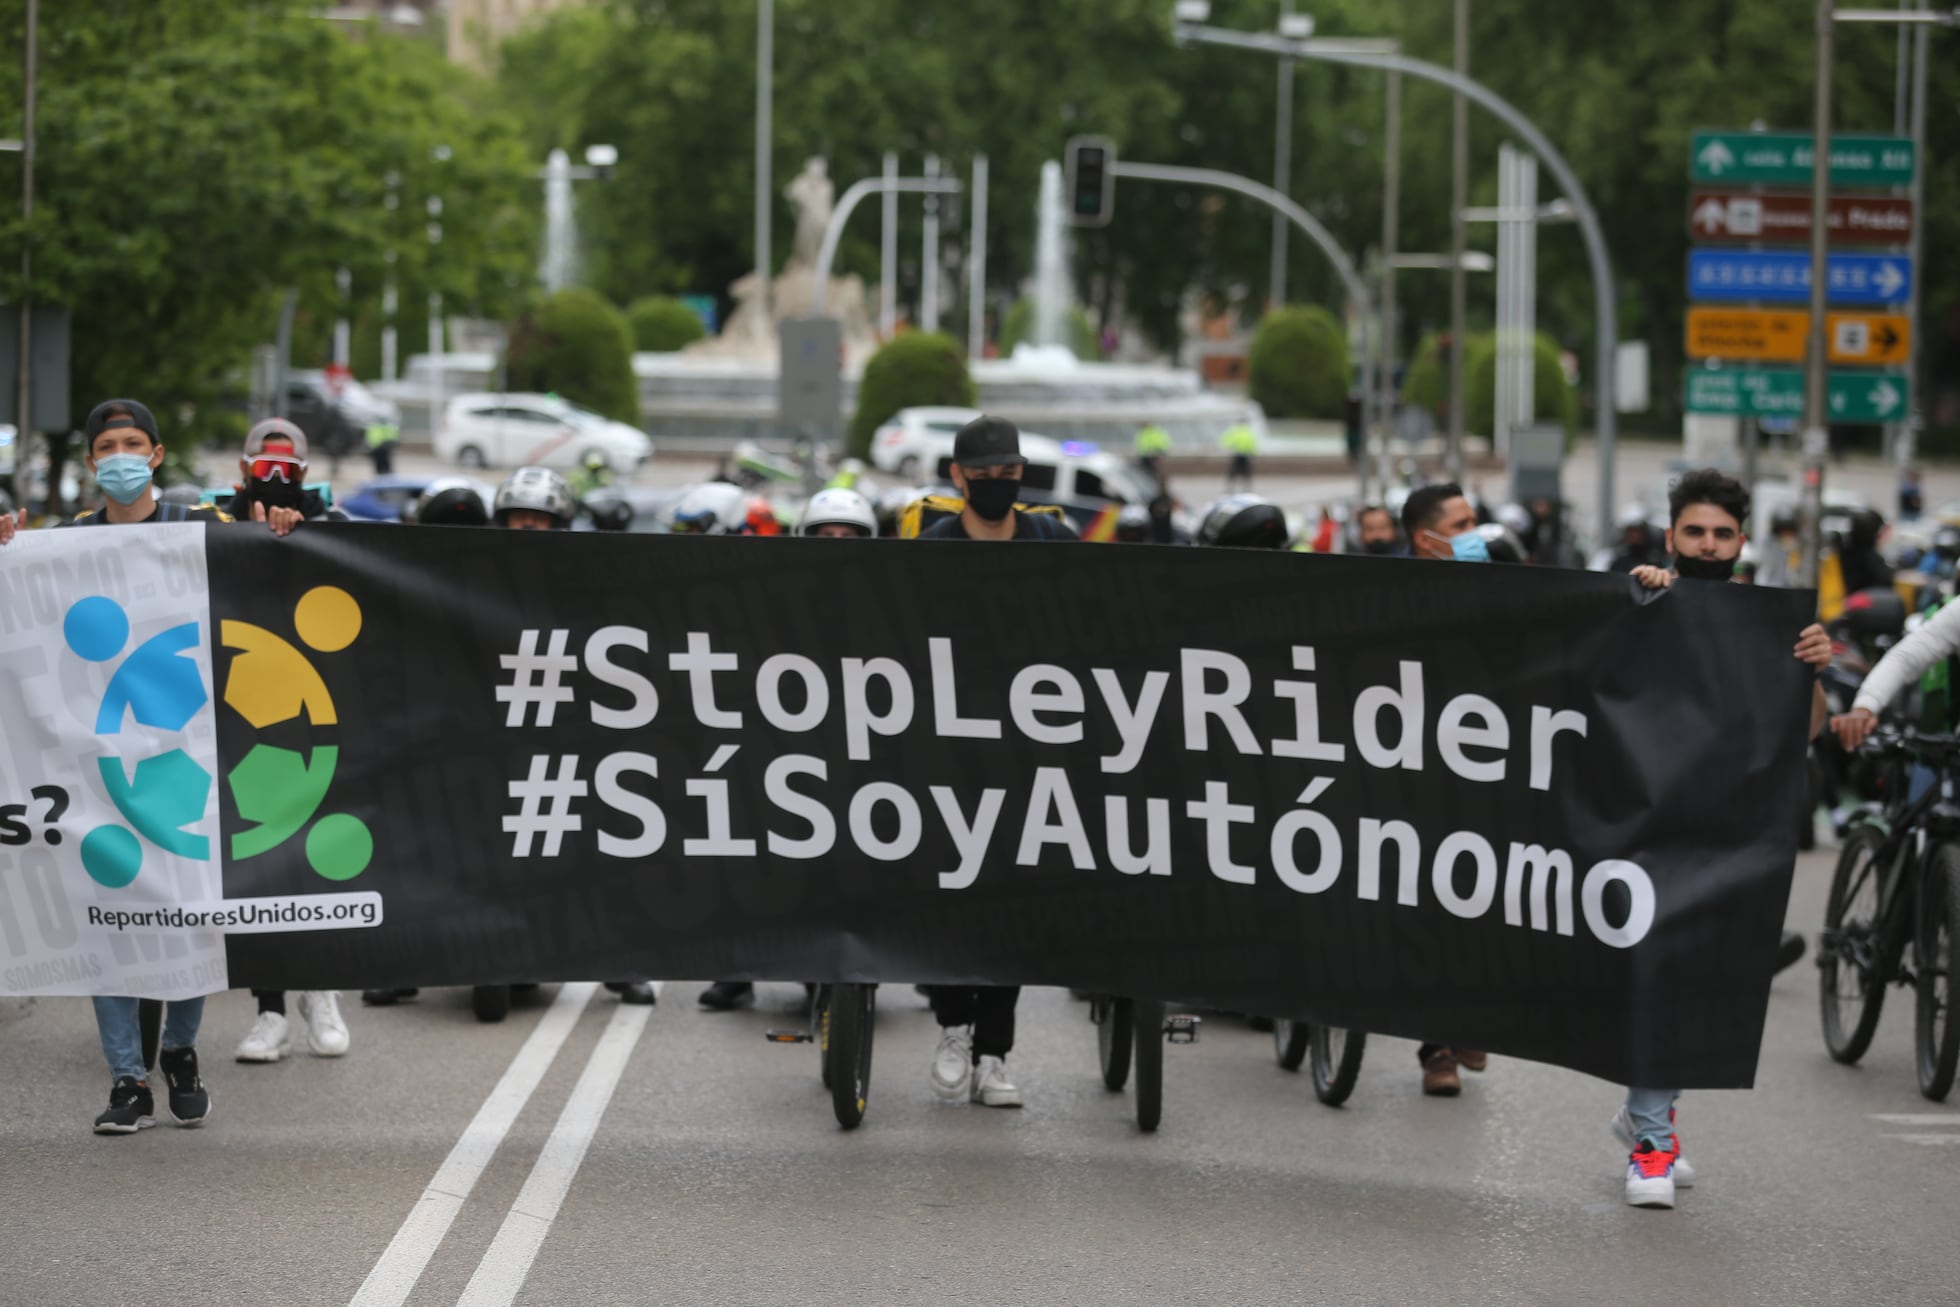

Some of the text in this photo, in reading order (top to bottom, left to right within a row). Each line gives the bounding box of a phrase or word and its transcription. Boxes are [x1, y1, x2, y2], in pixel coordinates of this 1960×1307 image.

[495, 625, 1587, 791] #StopLeyRider
[502, 744, 1656, 948] #SíSoyAutónomo
[87, 902, 376, 931] RepartidoresUnidos.org
[4, 952, 103, 992] SOMOSMAS
